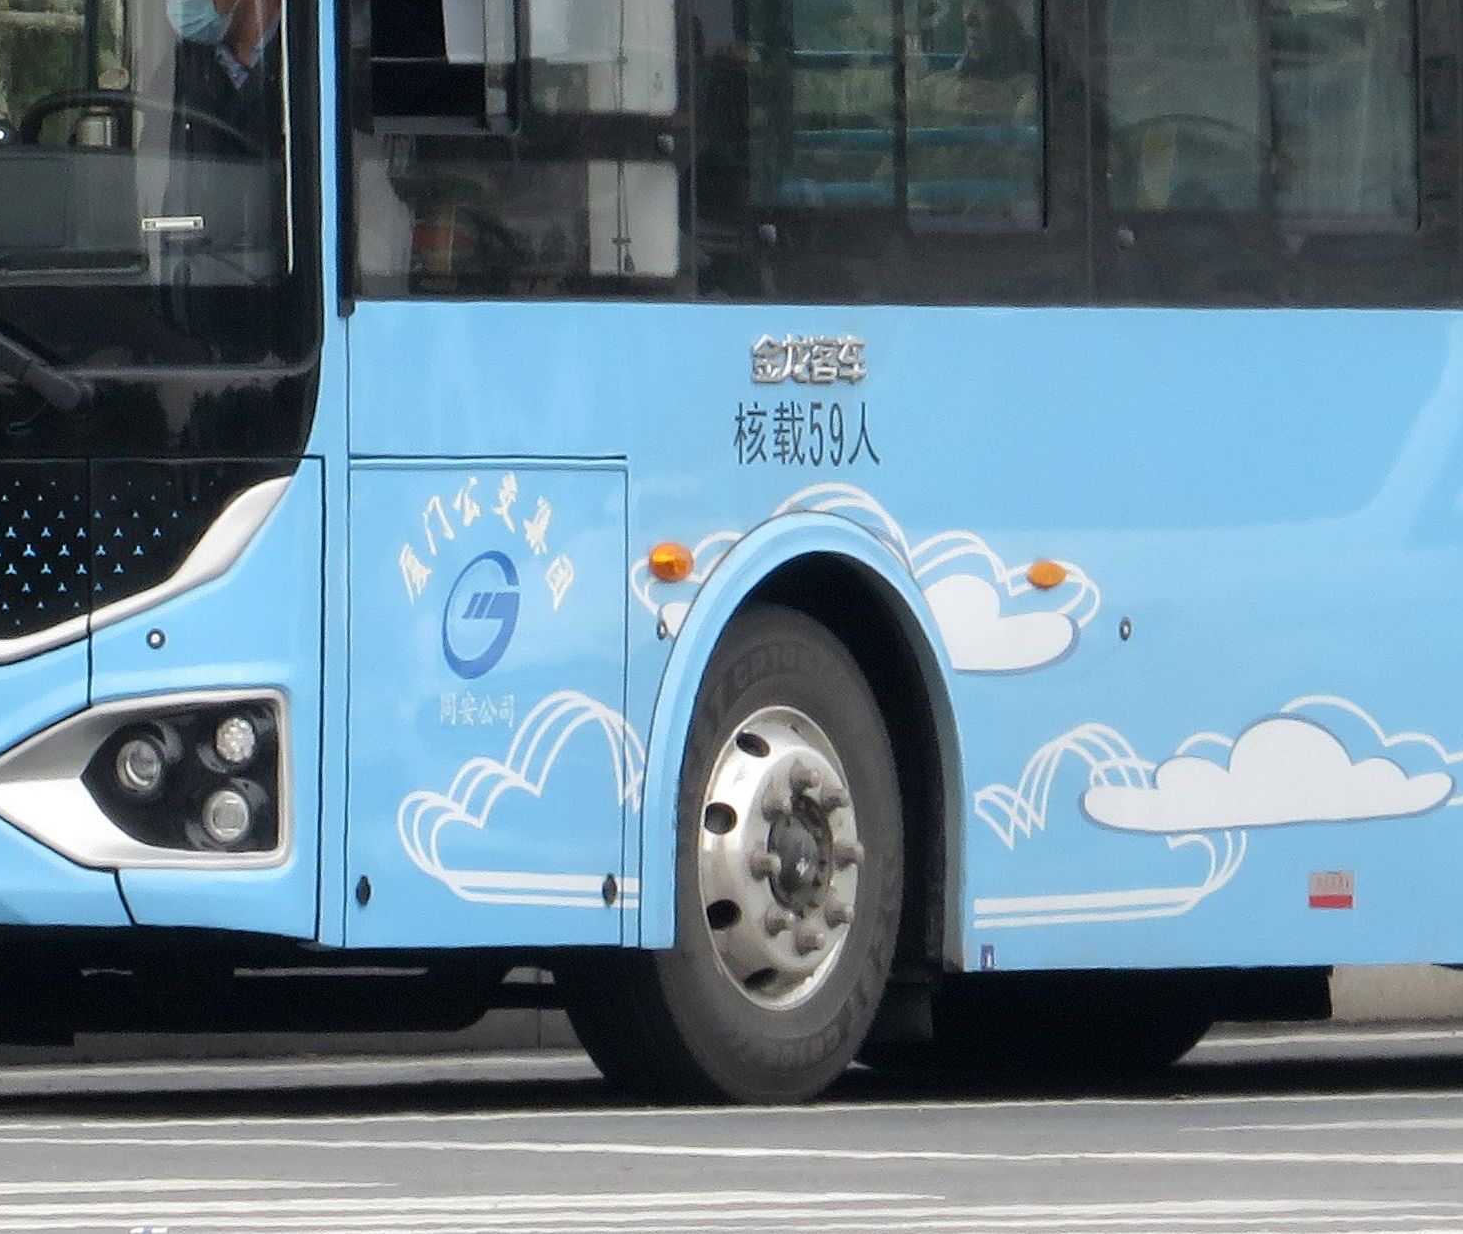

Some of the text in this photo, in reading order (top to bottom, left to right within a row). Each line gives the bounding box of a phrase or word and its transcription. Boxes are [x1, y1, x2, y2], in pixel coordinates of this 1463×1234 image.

[751, 333, 868, 385] 金龙客车
[733, 400, 881, 467] 核载59人
